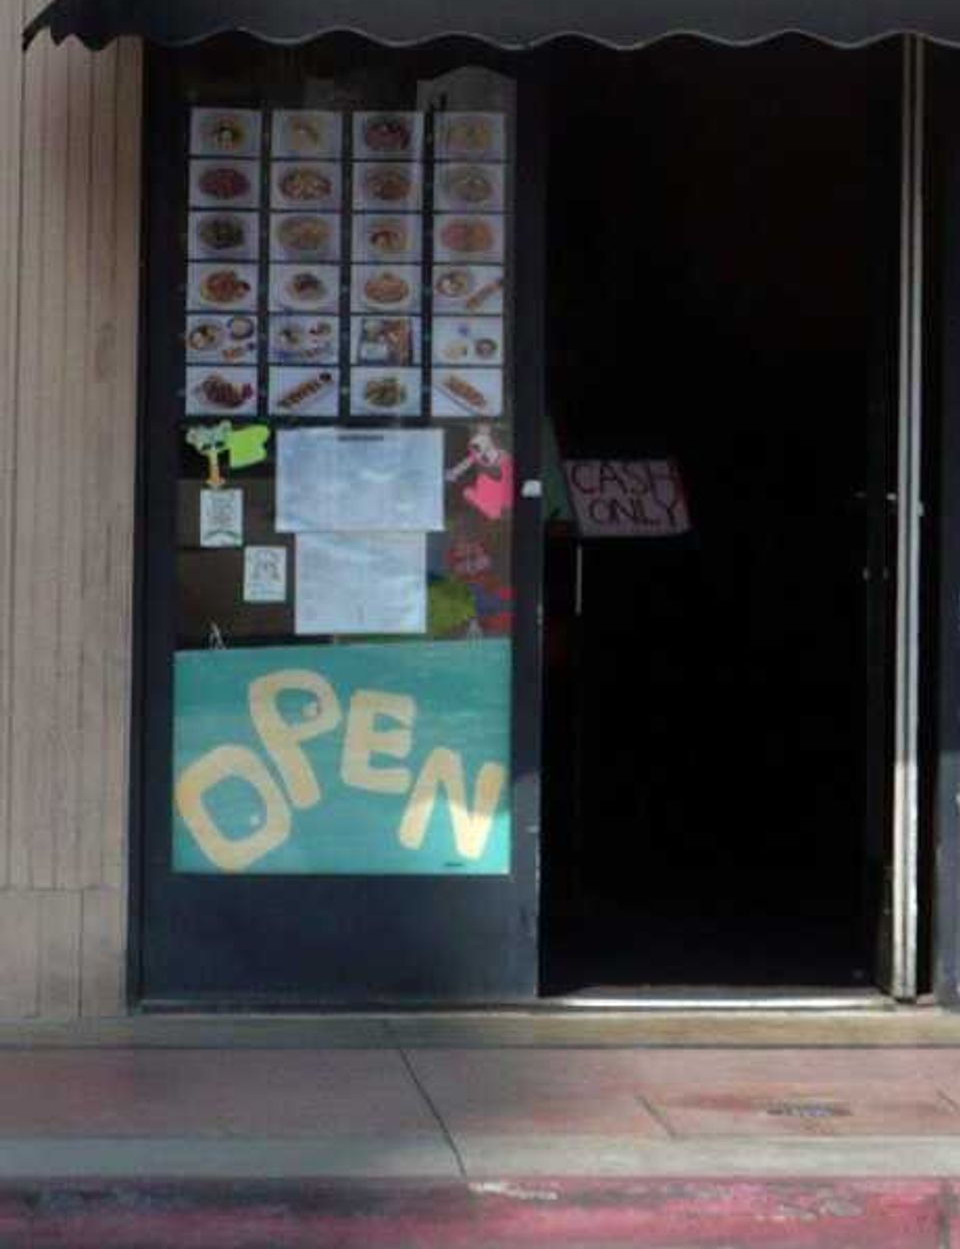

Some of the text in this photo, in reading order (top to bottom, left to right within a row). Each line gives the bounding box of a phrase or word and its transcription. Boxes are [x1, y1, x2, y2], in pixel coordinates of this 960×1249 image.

[571, 461, 681, 498] CASH
[589, 496, 681, 528] ONLY
[175, 668, 506, 871] OPEN
